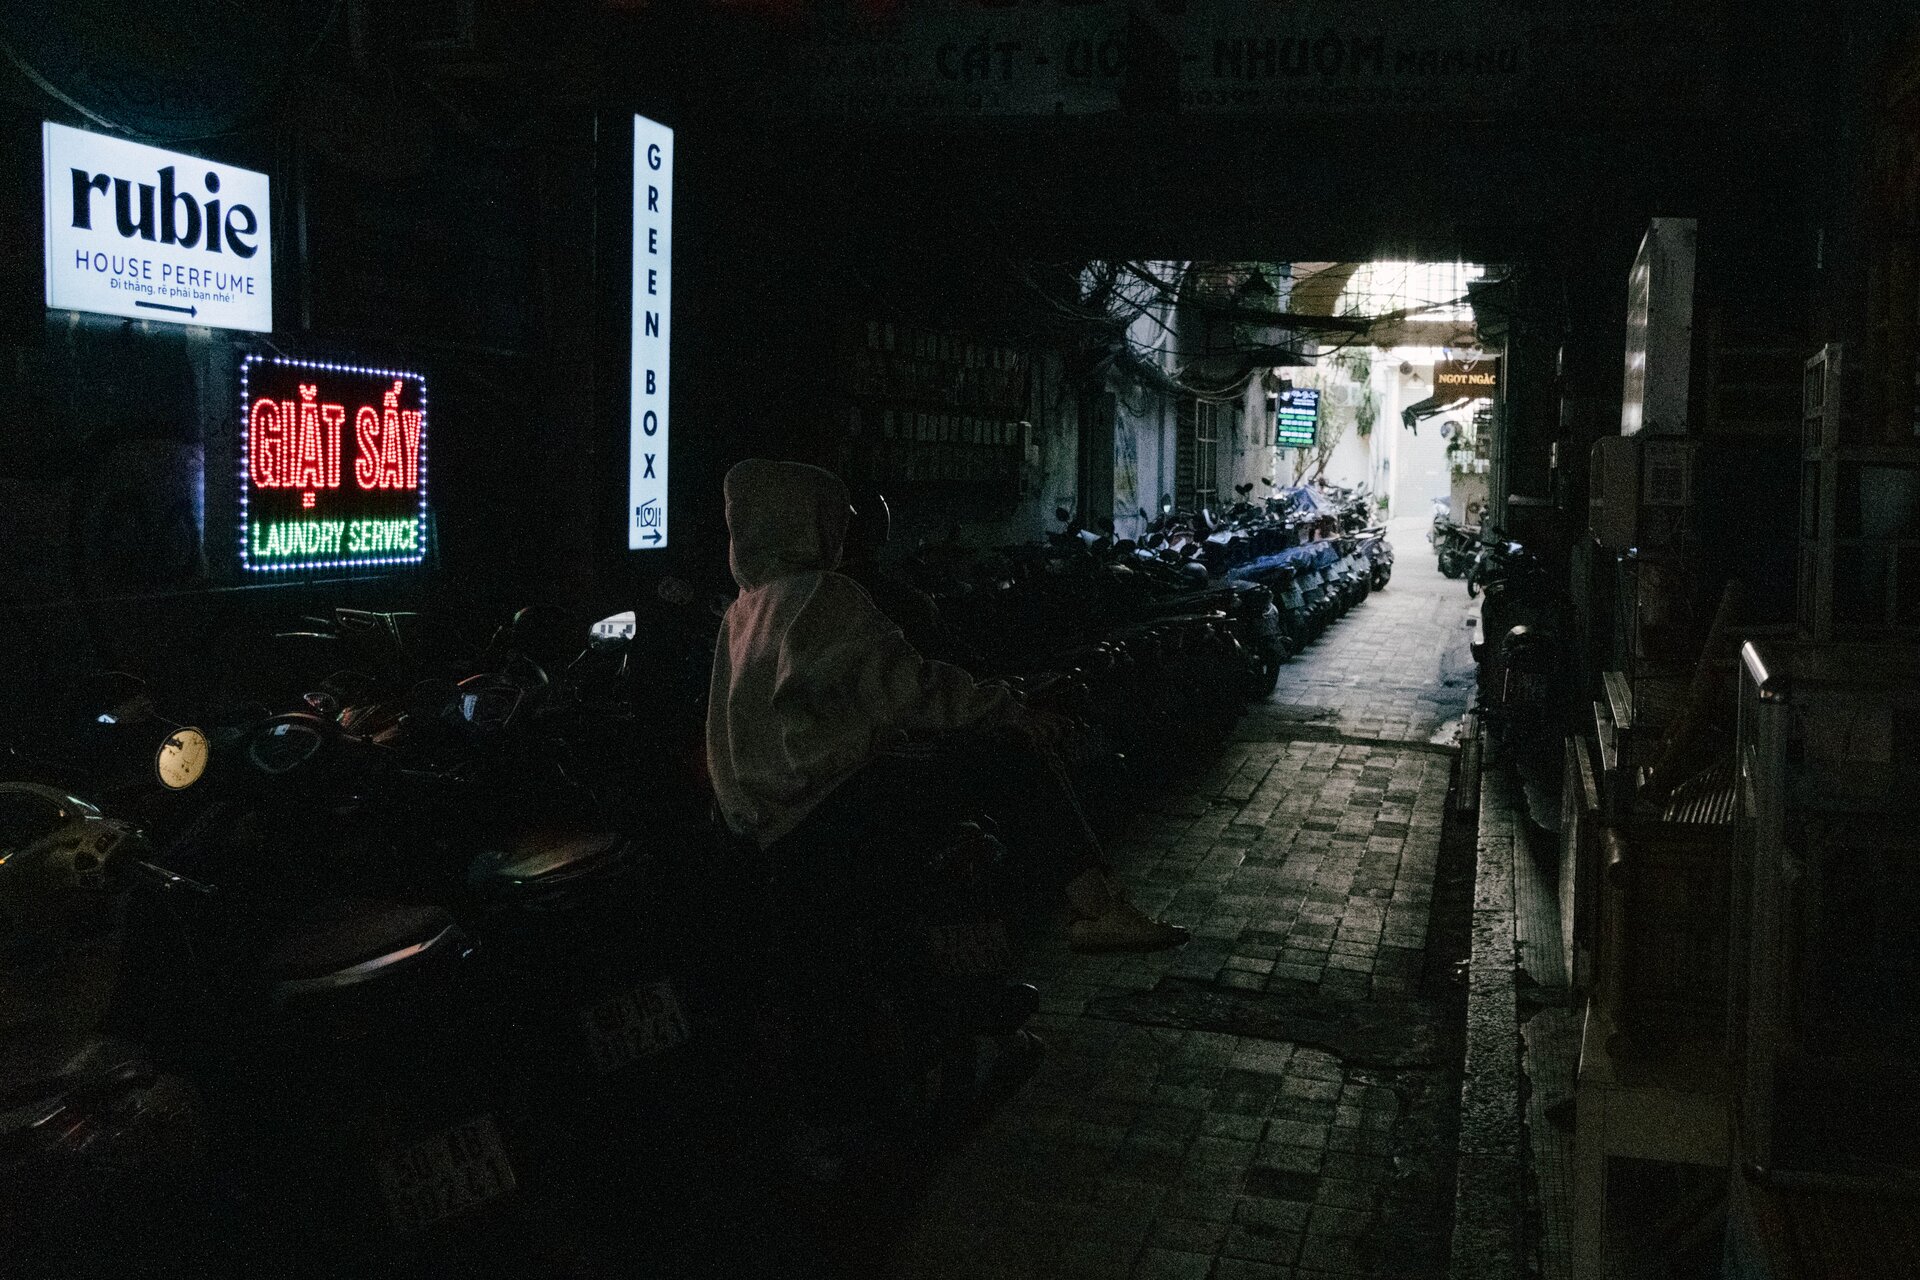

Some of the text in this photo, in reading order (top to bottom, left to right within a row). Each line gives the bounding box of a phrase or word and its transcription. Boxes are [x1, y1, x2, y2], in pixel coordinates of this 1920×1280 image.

[70, 165, 258, 259] rubie
[75, 249, 255, 296] HOUSE PERFUME
[110, 278, 122, 290] Đi
[193, 289, 211, 302] bạn
[643, 143, 662, 479] GREEN BOX
[250, 380, 422, 508] GIẶT SẤY
[252, 518, 419, 556] LAUNDRY SERVICE
